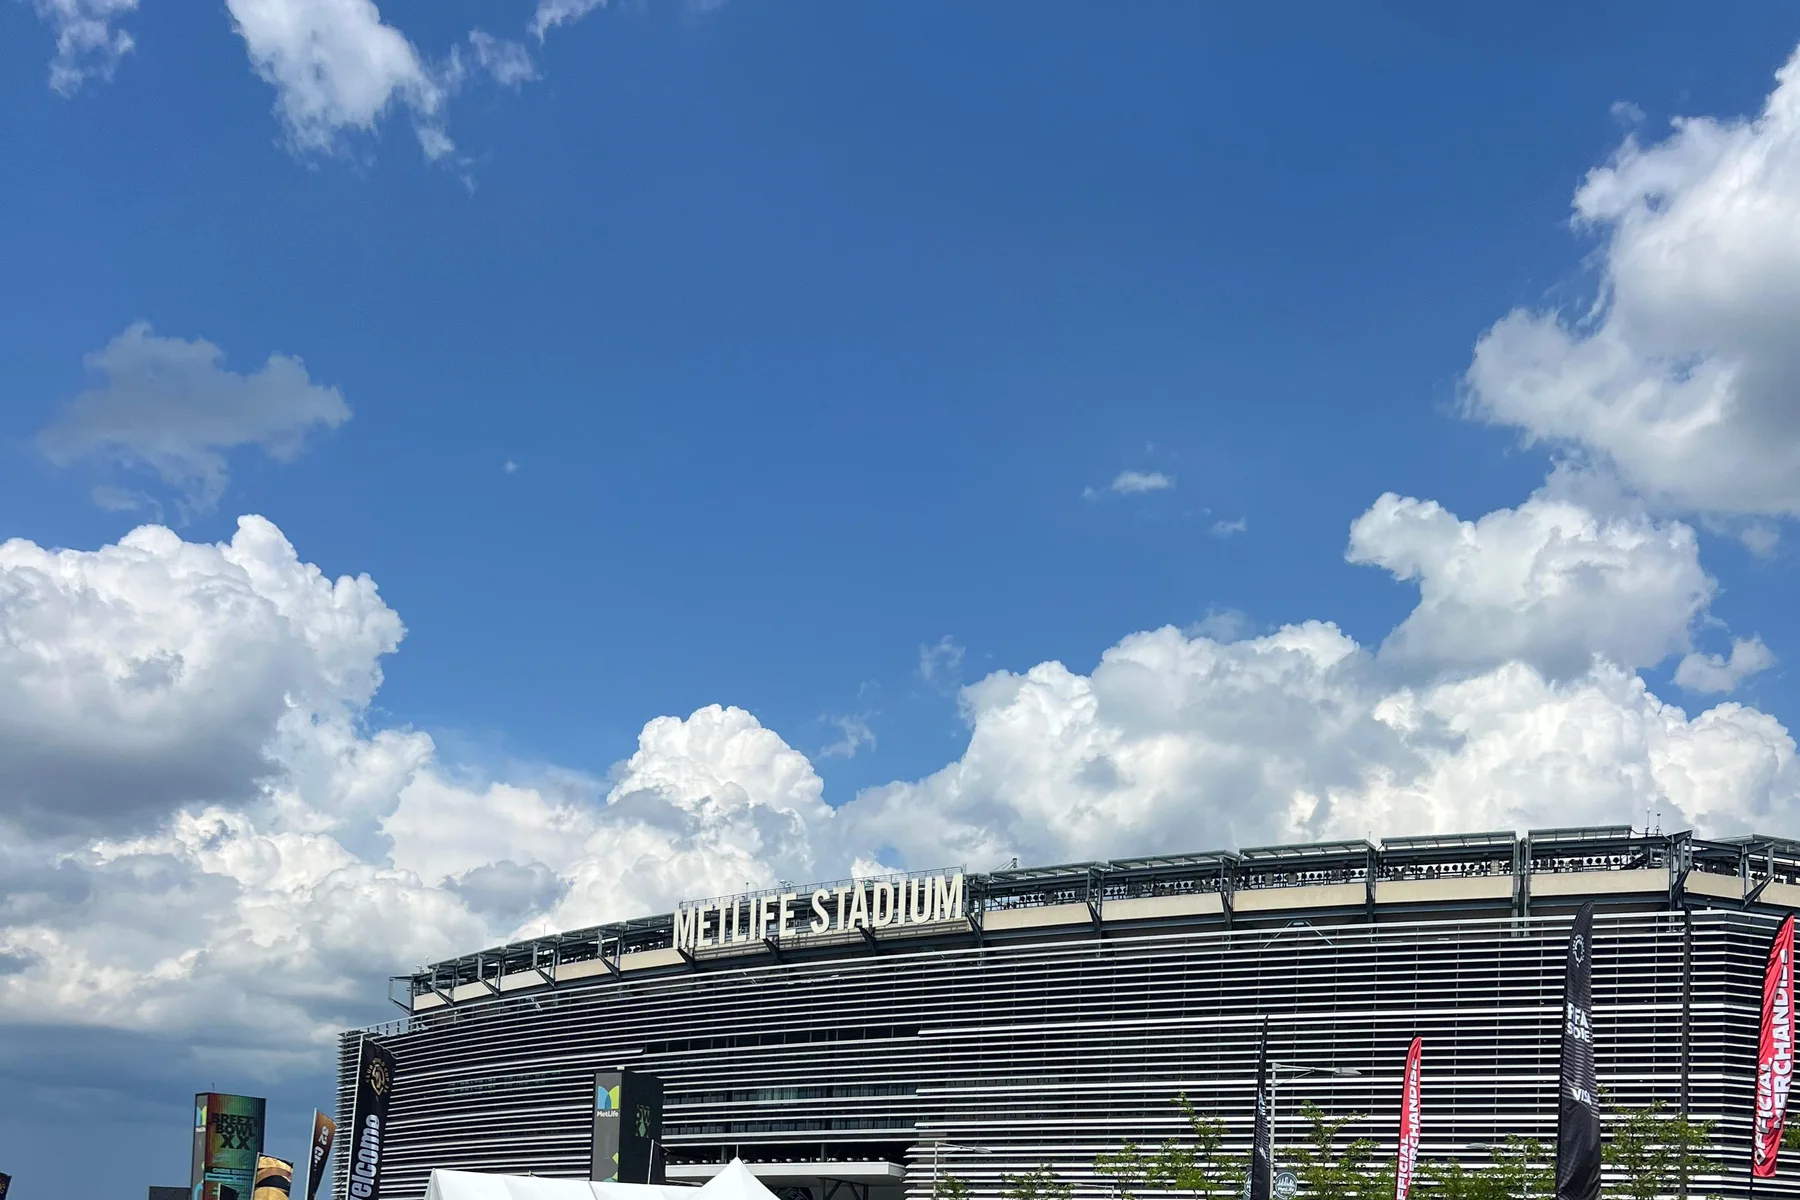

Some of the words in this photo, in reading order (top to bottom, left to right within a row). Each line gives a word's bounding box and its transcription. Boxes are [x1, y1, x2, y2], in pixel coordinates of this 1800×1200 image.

[673, 892, 797, 950] METLIFE
[810, 873, 964, 934] STADIUM
[1567, 1001, 1590, 1029] FFA
[1571, 1087, 1592, 1106] VISA
[1755, 1057, 1774, 1166] OFFICIAL
[215, 1123, 255, 1137] BOWL
